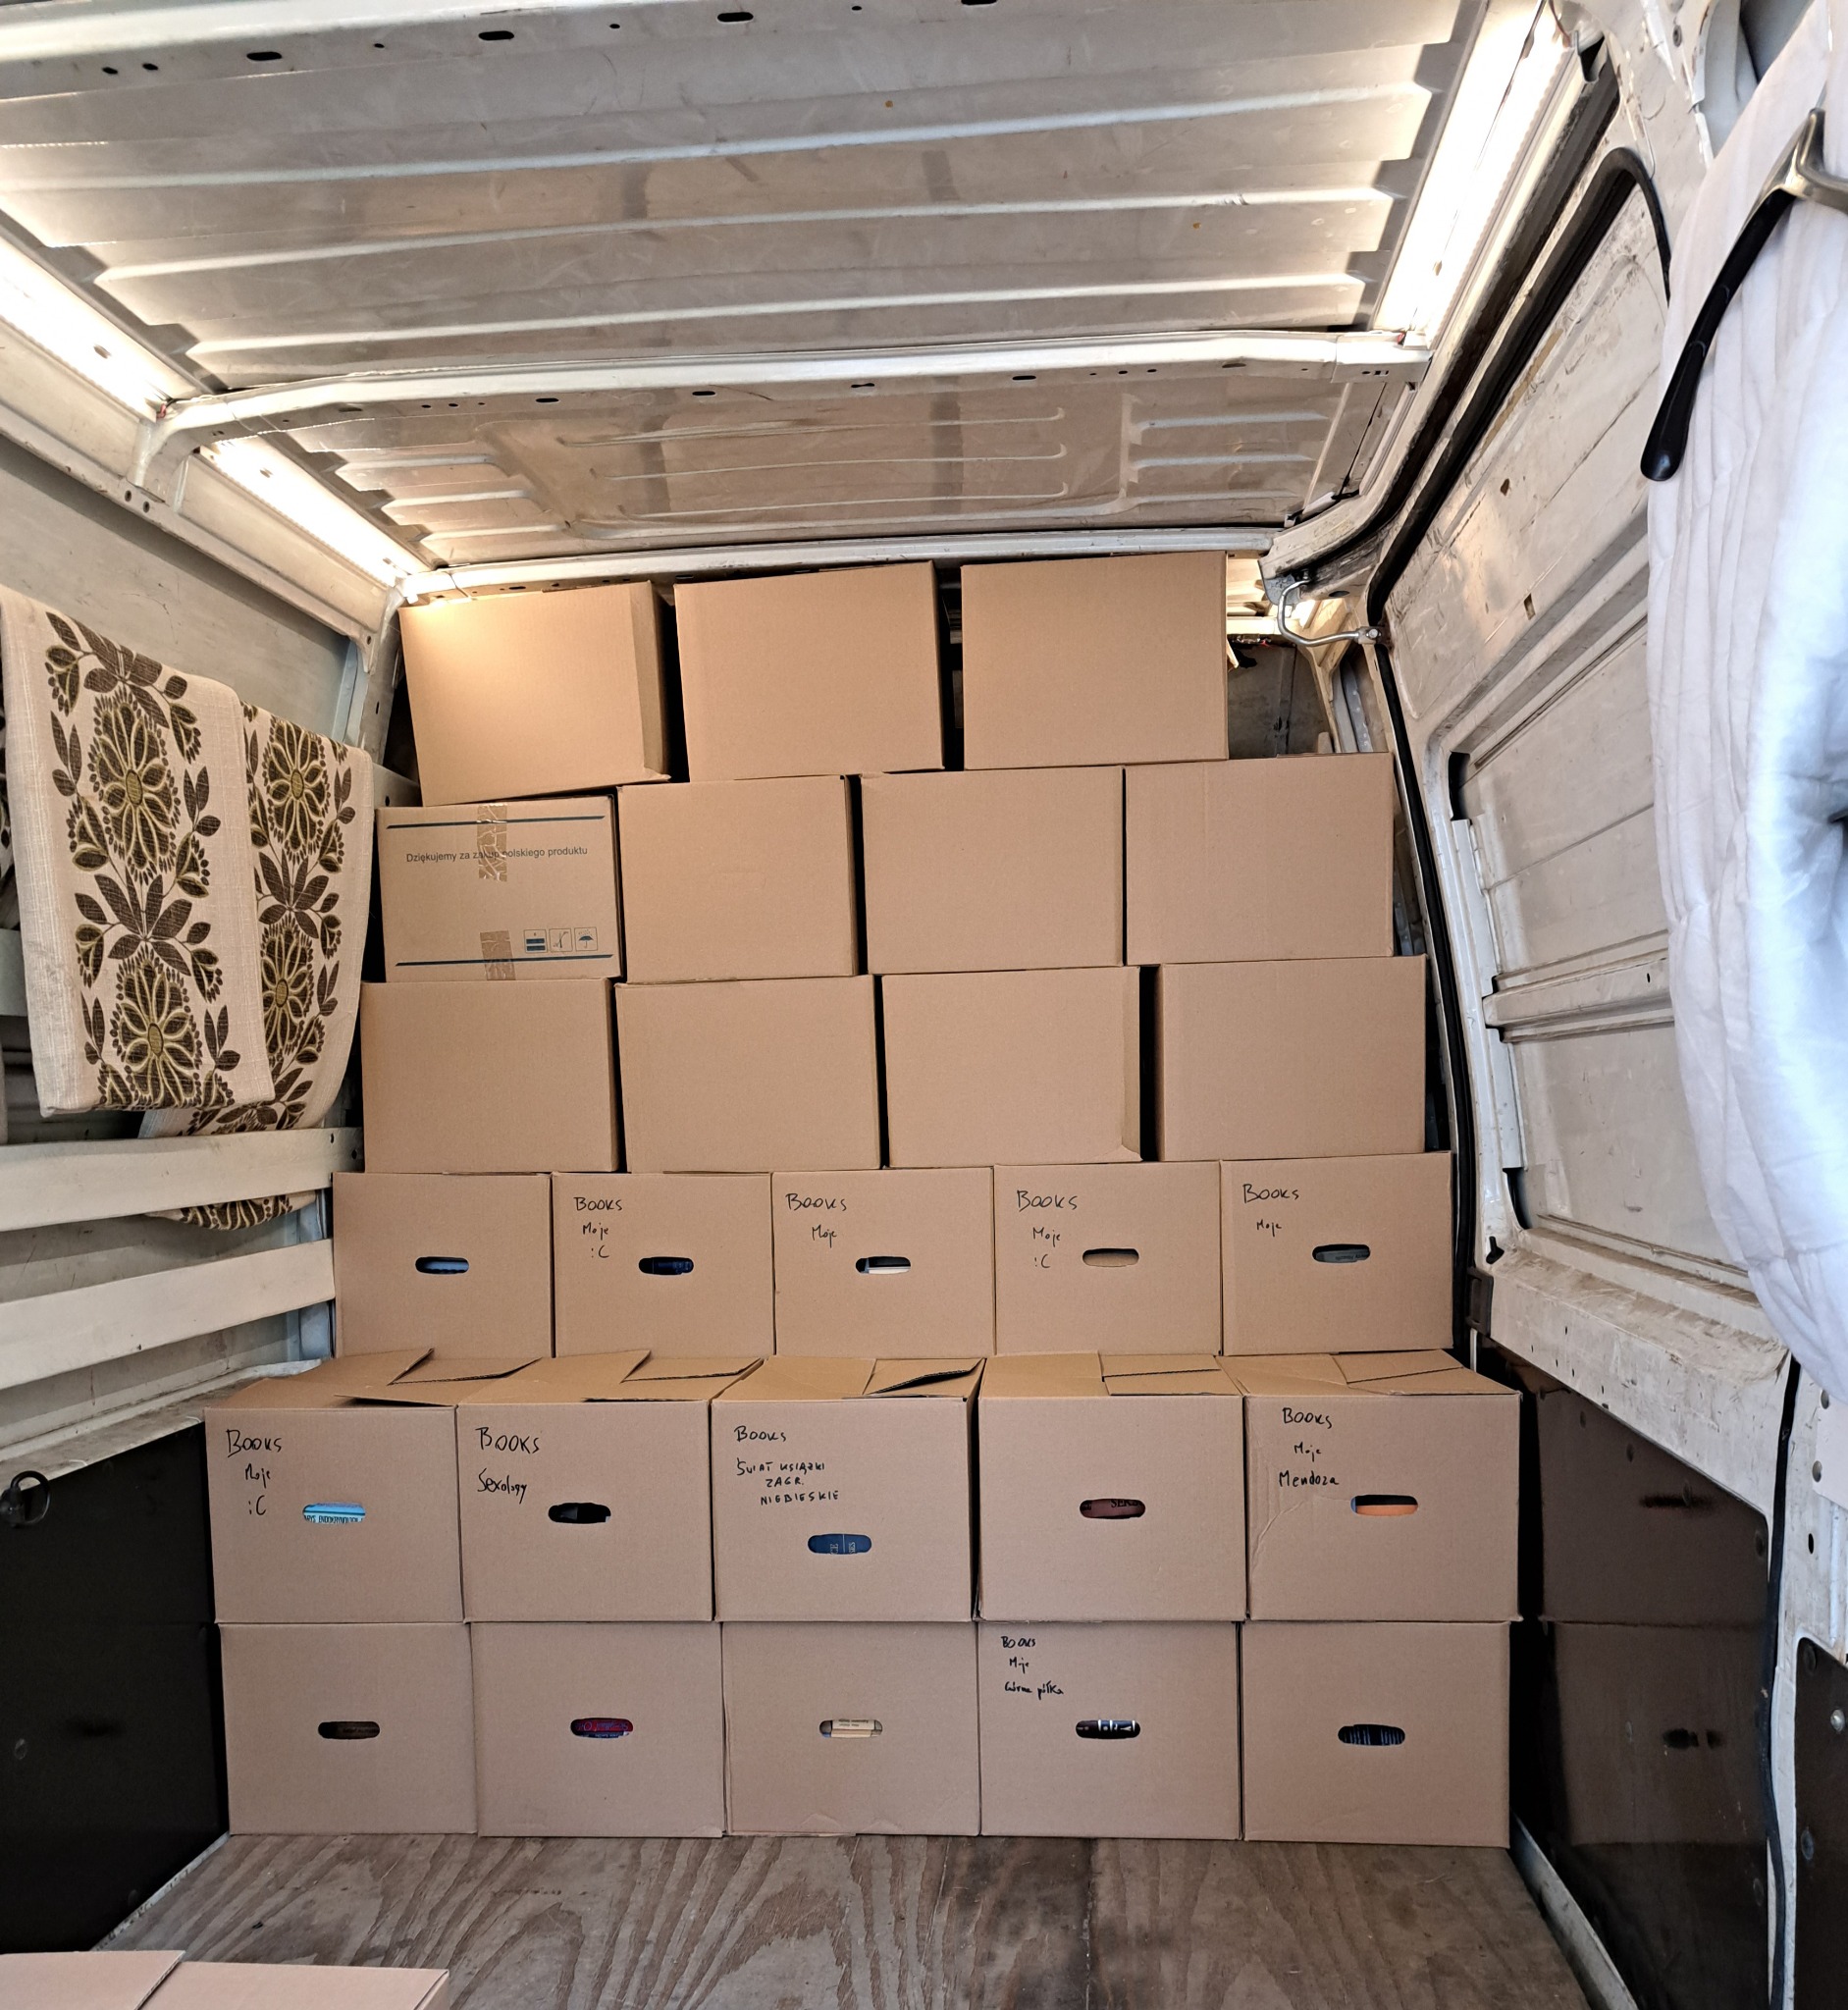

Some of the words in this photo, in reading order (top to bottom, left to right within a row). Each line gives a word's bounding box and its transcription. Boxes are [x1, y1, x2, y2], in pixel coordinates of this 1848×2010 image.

[405, 852, 457, 864] Dziękujemy
[473, 850, 500, 861] zakup
[548, 846, 588, 858] produktu
[785, 1191, 847, 1212] Books
[1016, 1190, 1078, 1213] Books
[1241, 1184, 1299, 1204] Books
[582, 1221, 609, 1242] Moje
[812, 1225, 837, 1248] Moje
[1032, 1226, 1061, 1248] Moje
[1256, 1219, 1283, 1237] Moje
[1294, 1441, 1322, 1463] Moje
[244, 1462, 271, 1489] Moje
[766, 1476, 805, 1488] ZAGR.
[1278, 1469, 1340, 1488] Mendoza
[476, 1467, 528, 1506] Sexology
[760, 1490, 839, 1507] NIEBIESKIE
[1009, 1656, 1030, 1674] Moje
